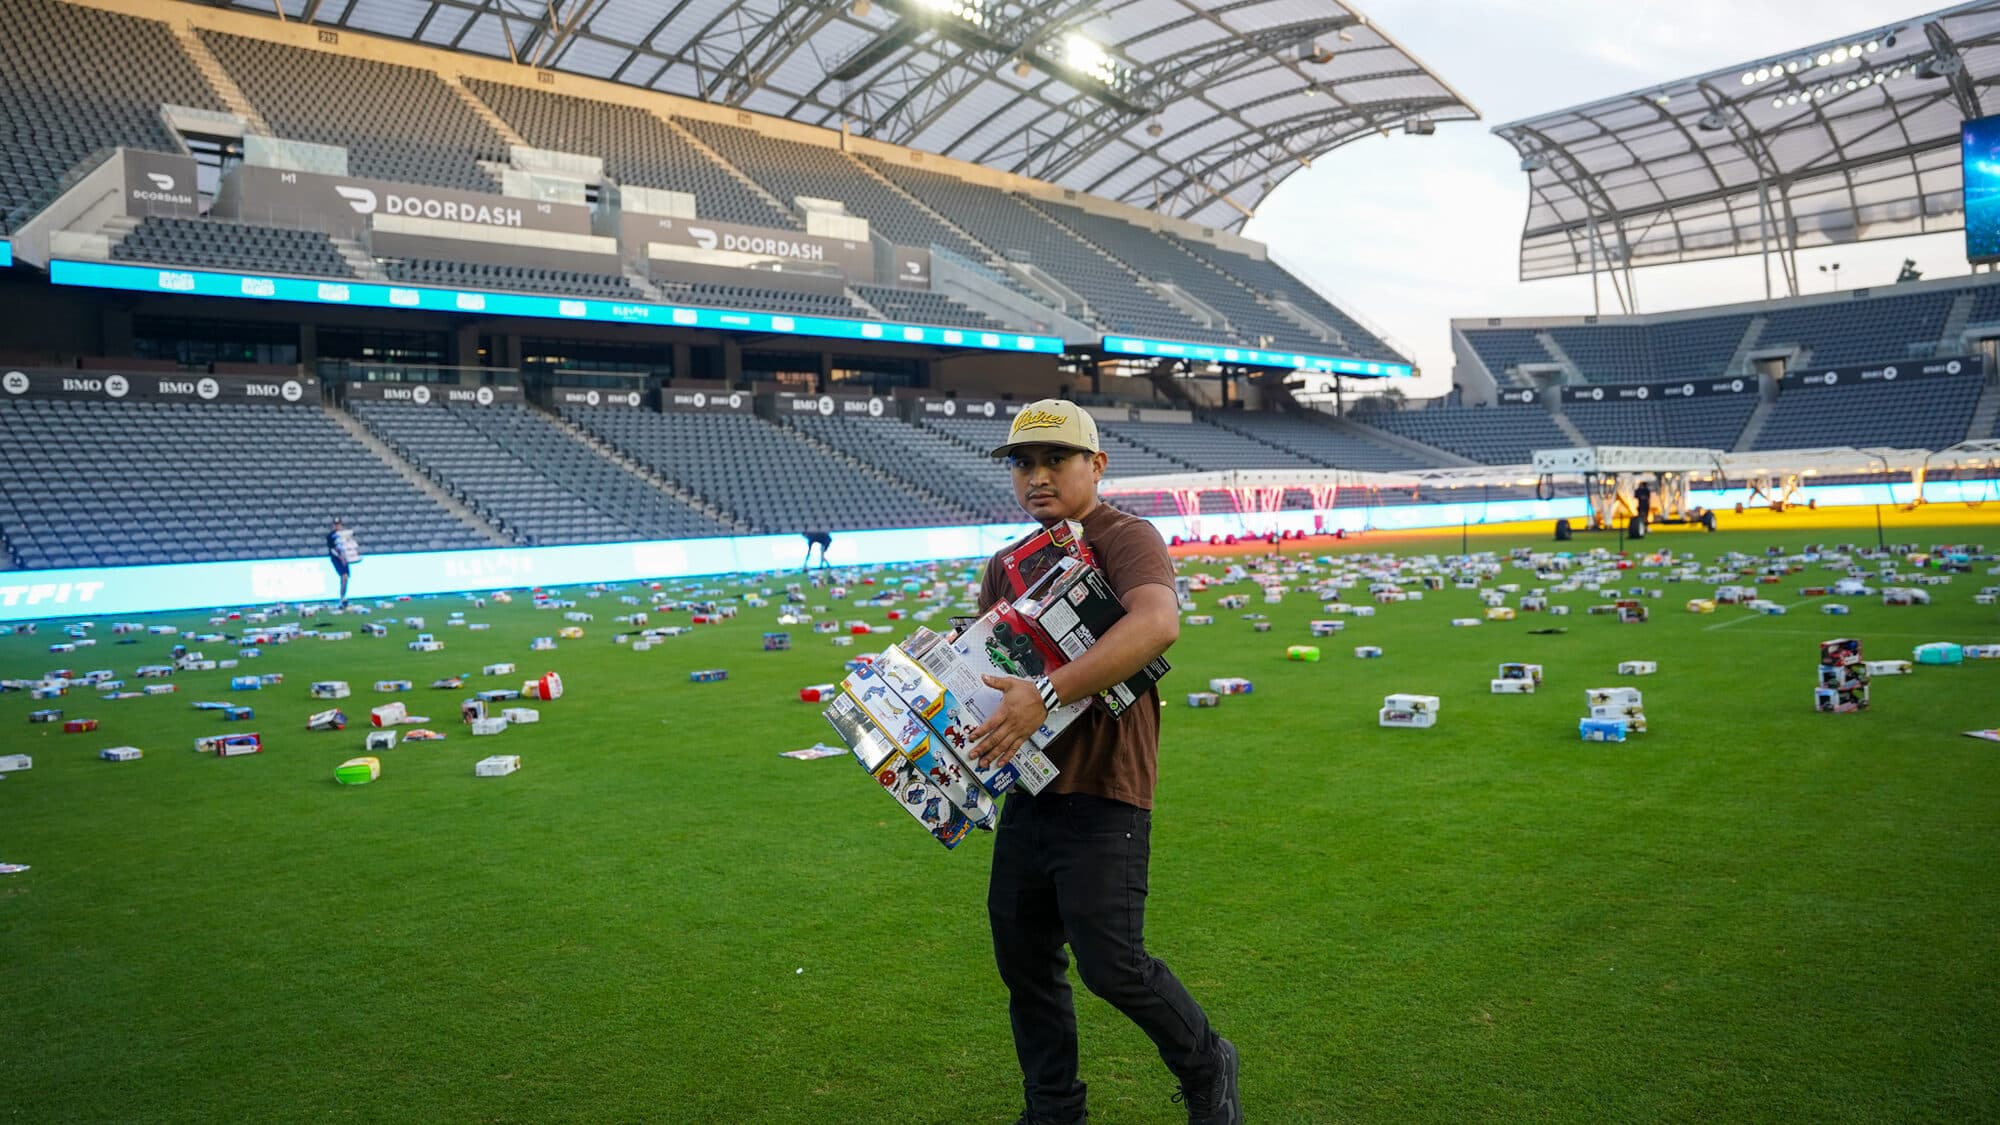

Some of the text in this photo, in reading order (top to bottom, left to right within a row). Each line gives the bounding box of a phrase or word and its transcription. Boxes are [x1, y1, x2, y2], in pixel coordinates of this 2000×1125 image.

[133, 189, 192, 204] DOORDASH
[386, 194, 522, 226] DOORDASH
[724, 233, 823, 261] DOORDASH
[63, 379, 101, 392] BMO
[159, 381, 194, 394] BMO
[246, 384, 279, 397] BMO
[384, 388, 411, 400] BMO
[450, 389, 475, 401] BMO
[793, 400, 817, 411] BMO
[844, 401, 868, 412] BMO
